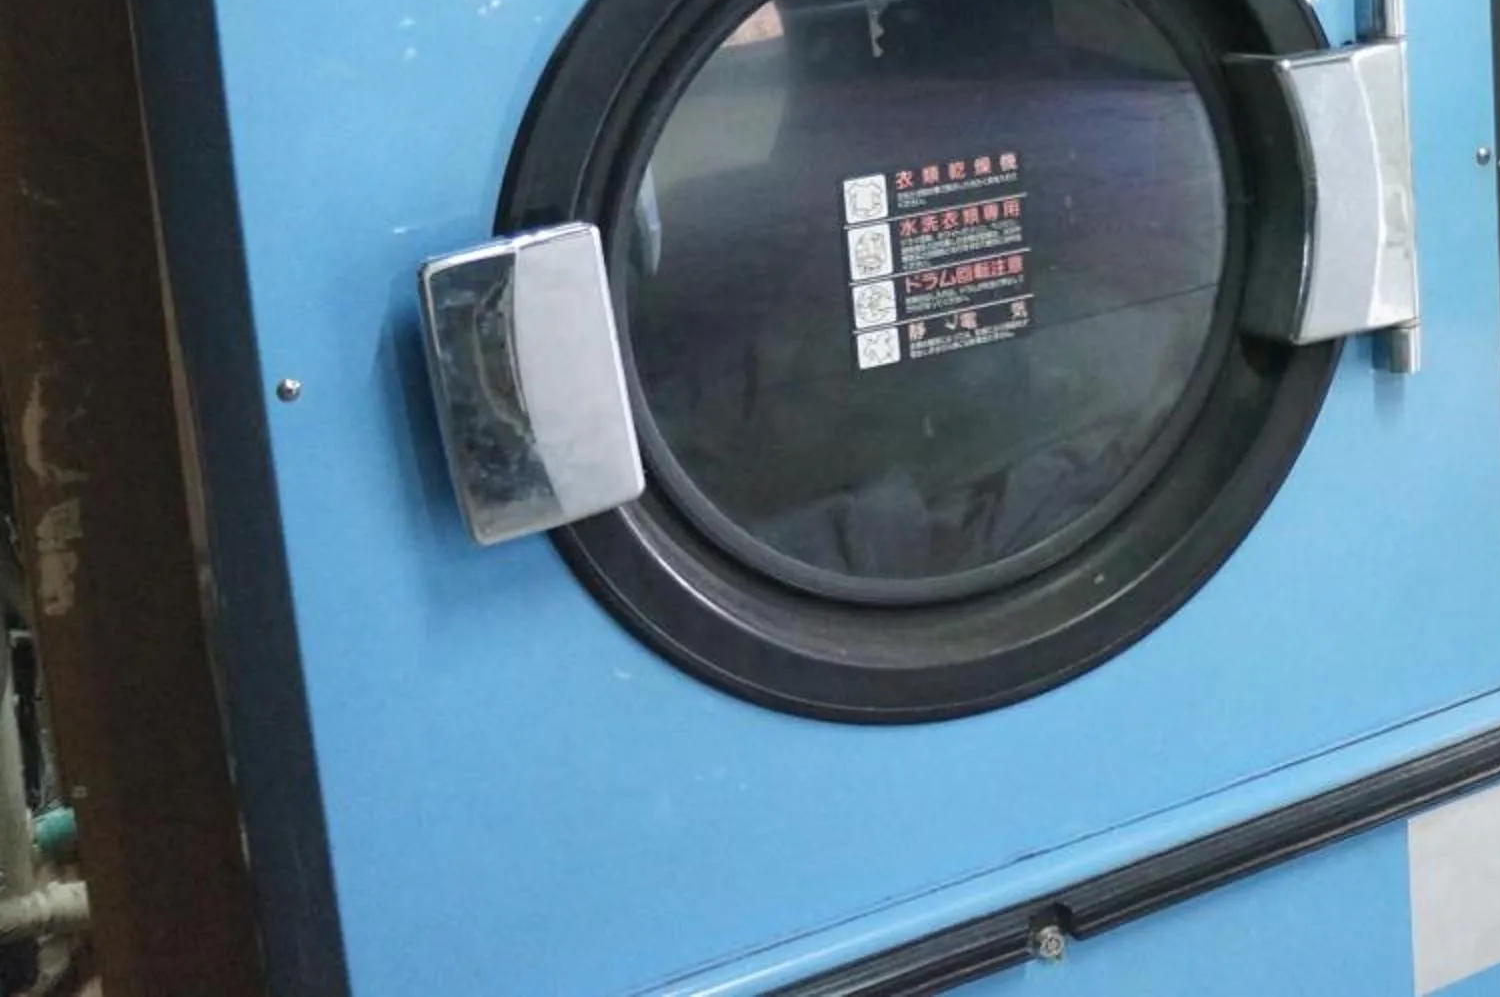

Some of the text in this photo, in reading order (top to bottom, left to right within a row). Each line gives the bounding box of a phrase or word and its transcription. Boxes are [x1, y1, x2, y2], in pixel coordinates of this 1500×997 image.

[895, 152, 1018, 190] 衣類乾燥機
[899, 198, 1021, 235] 水洗衣類専用
[905, 254, 1024, 293] ドラム回転注意
